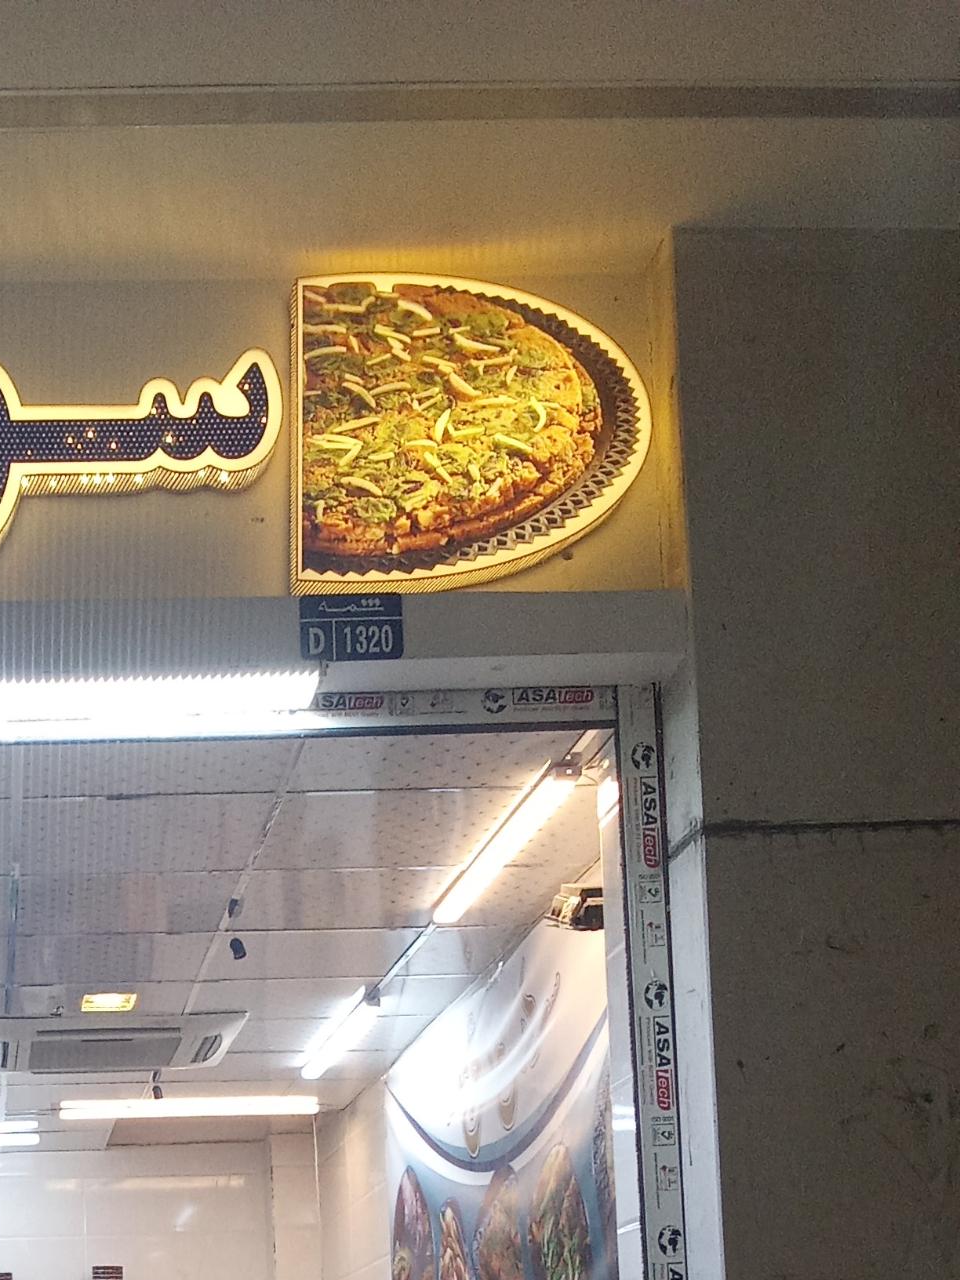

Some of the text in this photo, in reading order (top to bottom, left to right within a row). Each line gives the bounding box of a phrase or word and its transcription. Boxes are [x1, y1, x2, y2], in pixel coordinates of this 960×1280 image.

[309, 624, 393, 656] D 1320
[642, 781, 660, 868] ASATech
[655, 1021, 674, 1112] ASATech
